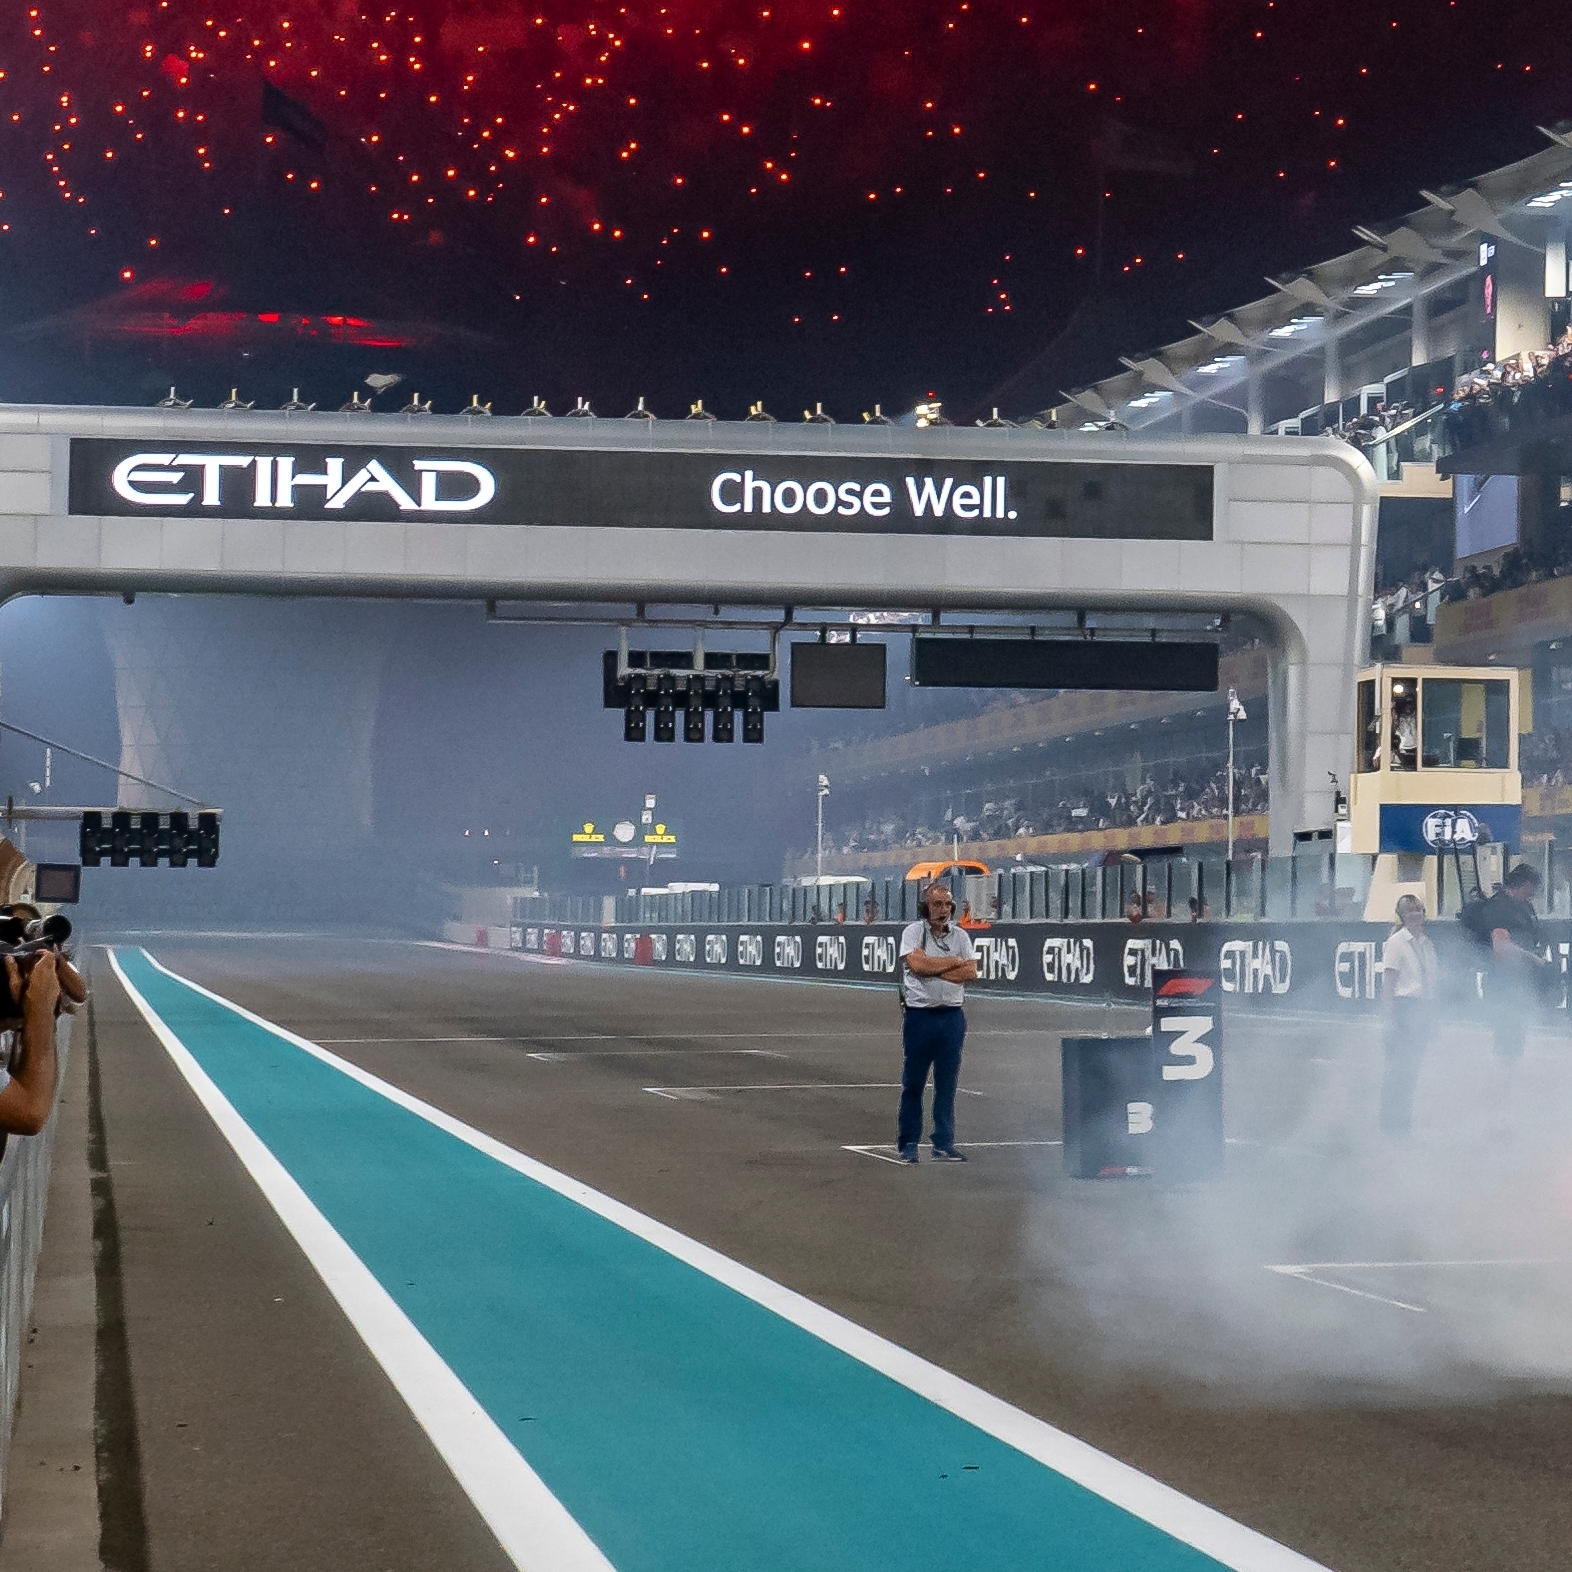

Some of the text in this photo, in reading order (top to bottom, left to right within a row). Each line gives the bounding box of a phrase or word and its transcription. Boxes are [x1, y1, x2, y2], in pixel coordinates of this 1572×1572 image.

[111, 452, 497, 512] ETIHAD
[710, 469, 1018, 520] Choose Well.
[815, 935, 847, 971] ETIHAD
[861, 935, 897, 974] ETIHAD
[1043, 937, 1096, 984] ETIHAD
[1219, 939, 1294, 995] ETIHAD
[1334, 941, 1386, 999] ETIH
[1160, 1015, 1215, 1081] 3
